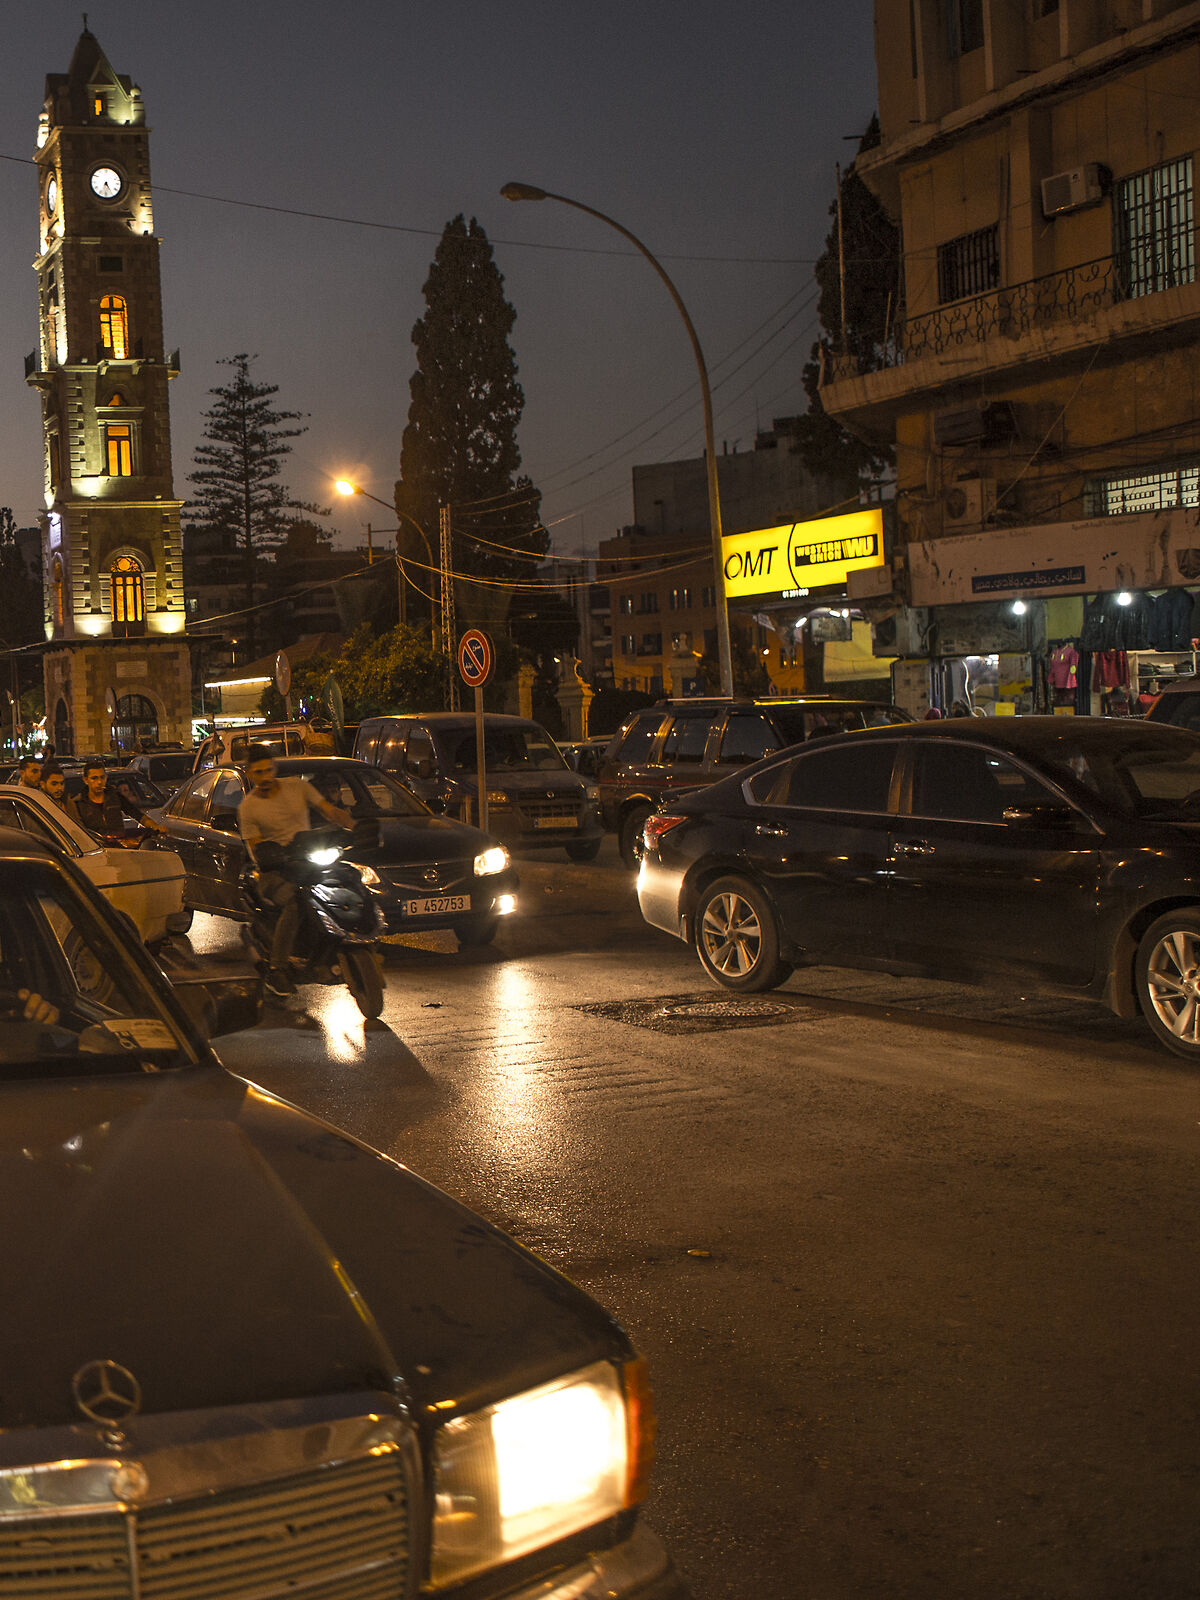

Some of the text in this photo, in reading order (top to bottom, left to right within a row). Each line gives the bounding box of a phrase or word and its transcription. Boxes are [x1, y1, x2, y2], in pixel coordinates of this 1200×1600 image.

[796, 540, 842, 557] WESTERN
[845, 535, 874, 558] WU
[724, 546, 779, 581] OMT
[809, 549, 842, 564] UNION
[410, 897, 464, 914] G 452753
